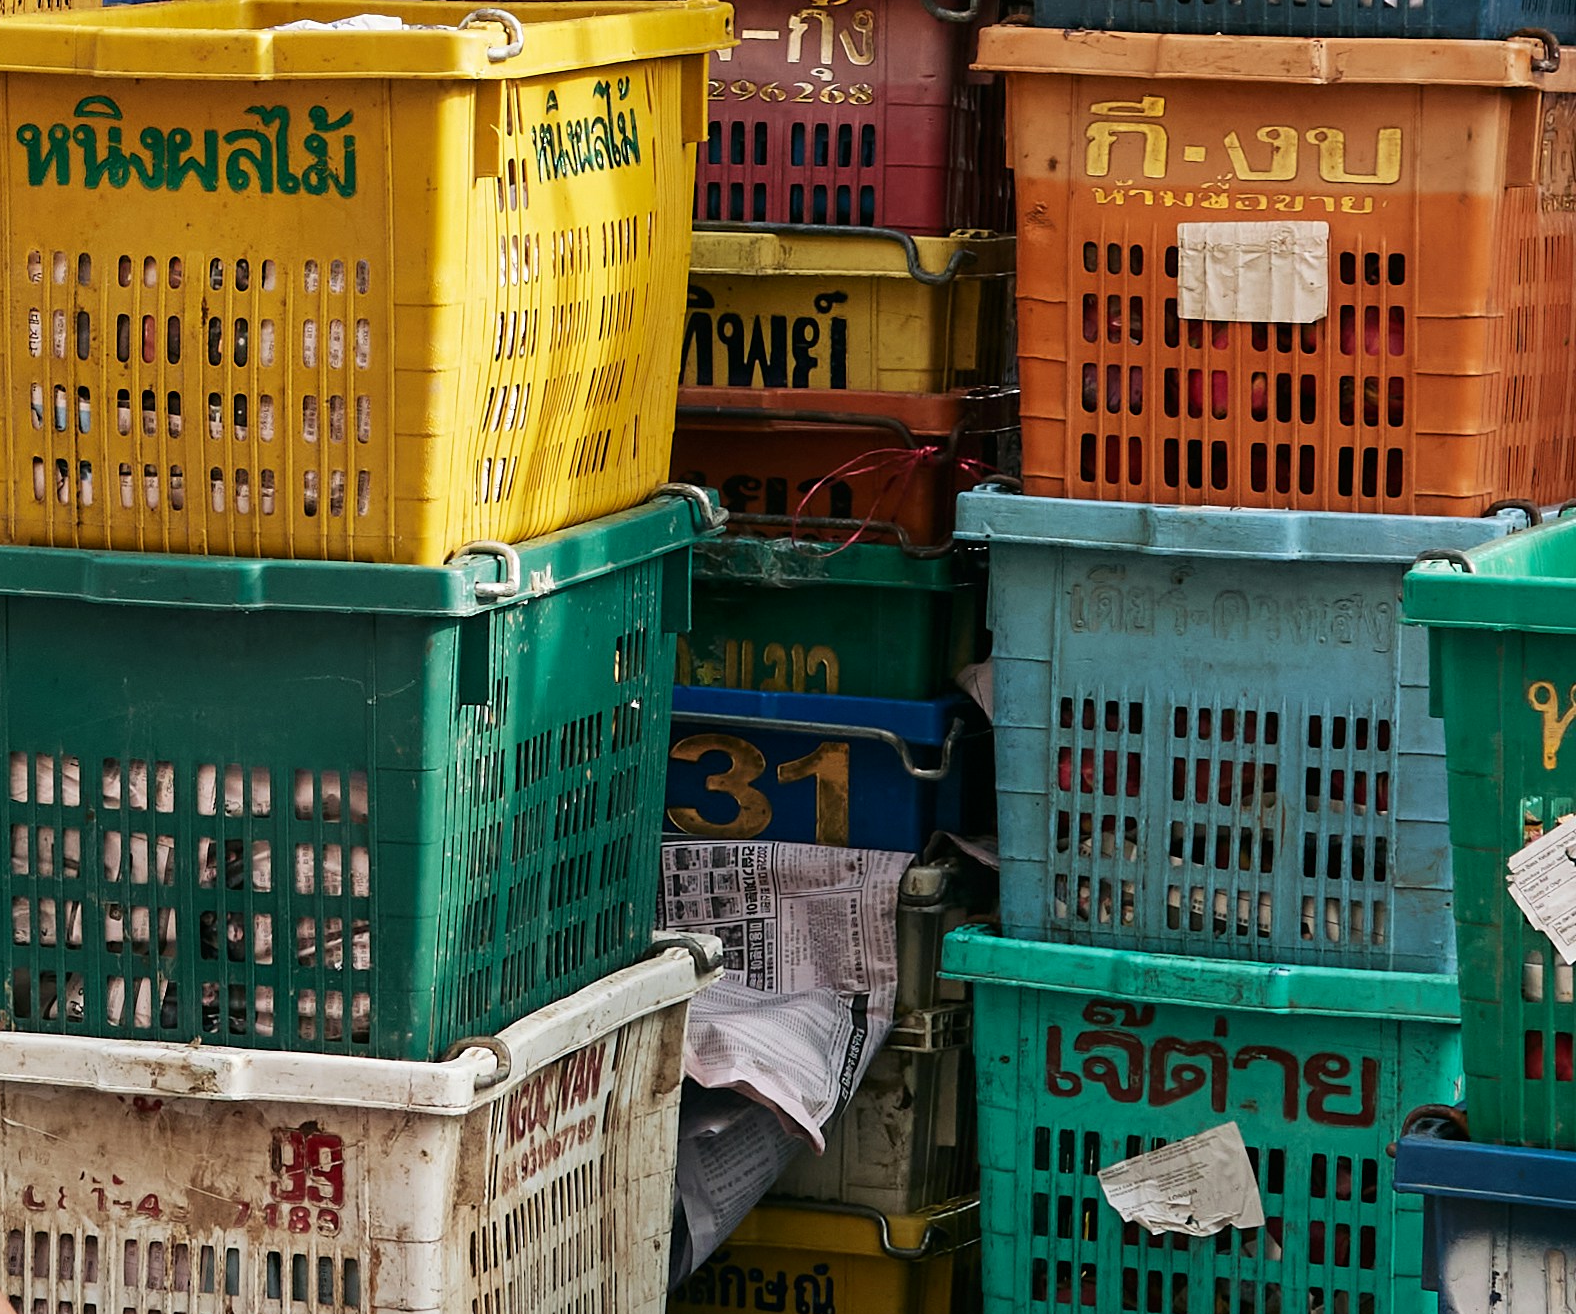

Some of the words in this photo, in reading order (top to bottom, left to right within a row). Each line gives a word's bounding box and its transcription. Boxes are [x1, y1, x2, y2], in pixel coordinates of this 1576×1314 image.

[15, 94, 358, 199] หนิงผลไม้
[531, 76, 642, 184] หนิงผลไม้
[1046, 999, 1379, 1129] เจ๊ต่าย
